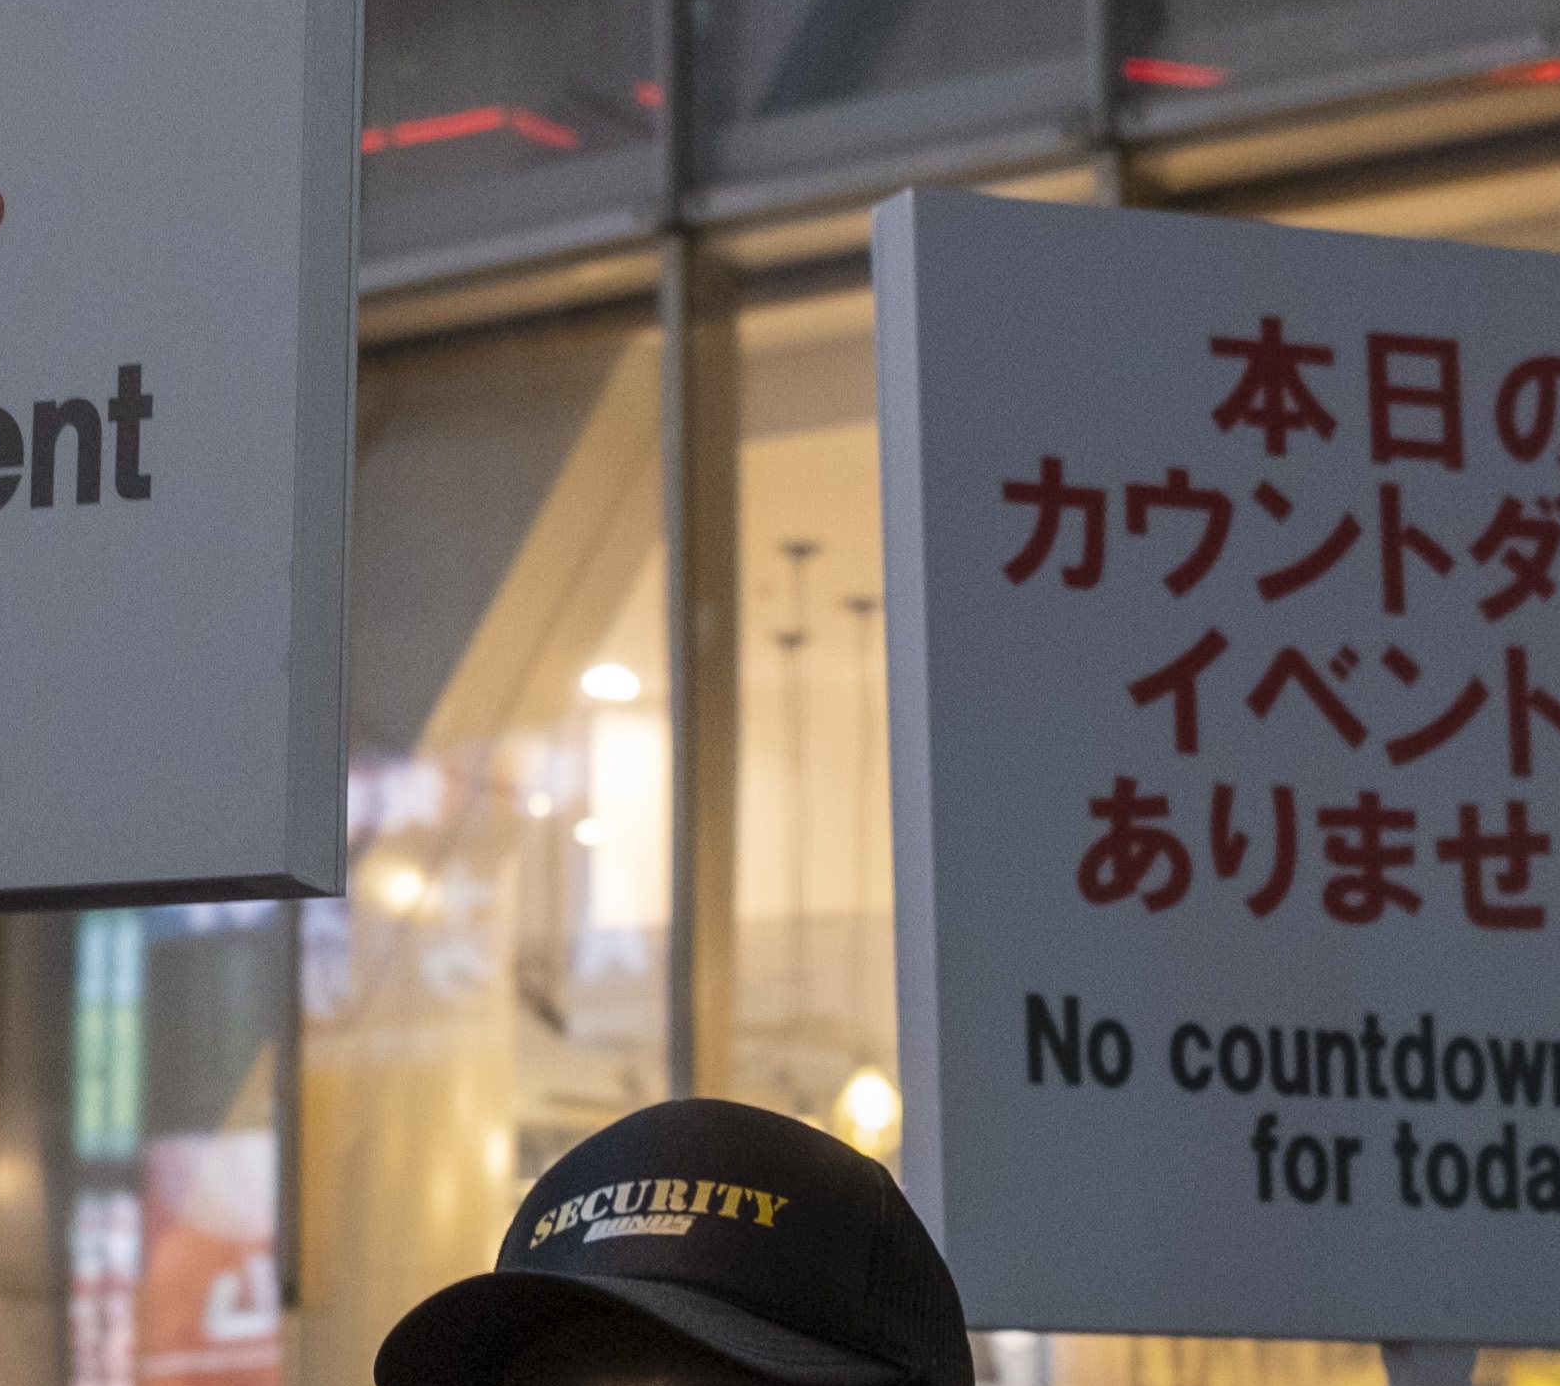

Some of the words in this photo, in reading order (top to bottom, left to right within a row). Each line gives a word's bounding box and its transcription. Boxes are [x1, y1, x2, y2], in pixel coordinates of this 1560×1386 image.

[1023, 991, 1136, 1091] No
[1249, 1112, 1363, 1206] for
[529, 1178, 790, 1251] SECURITY
